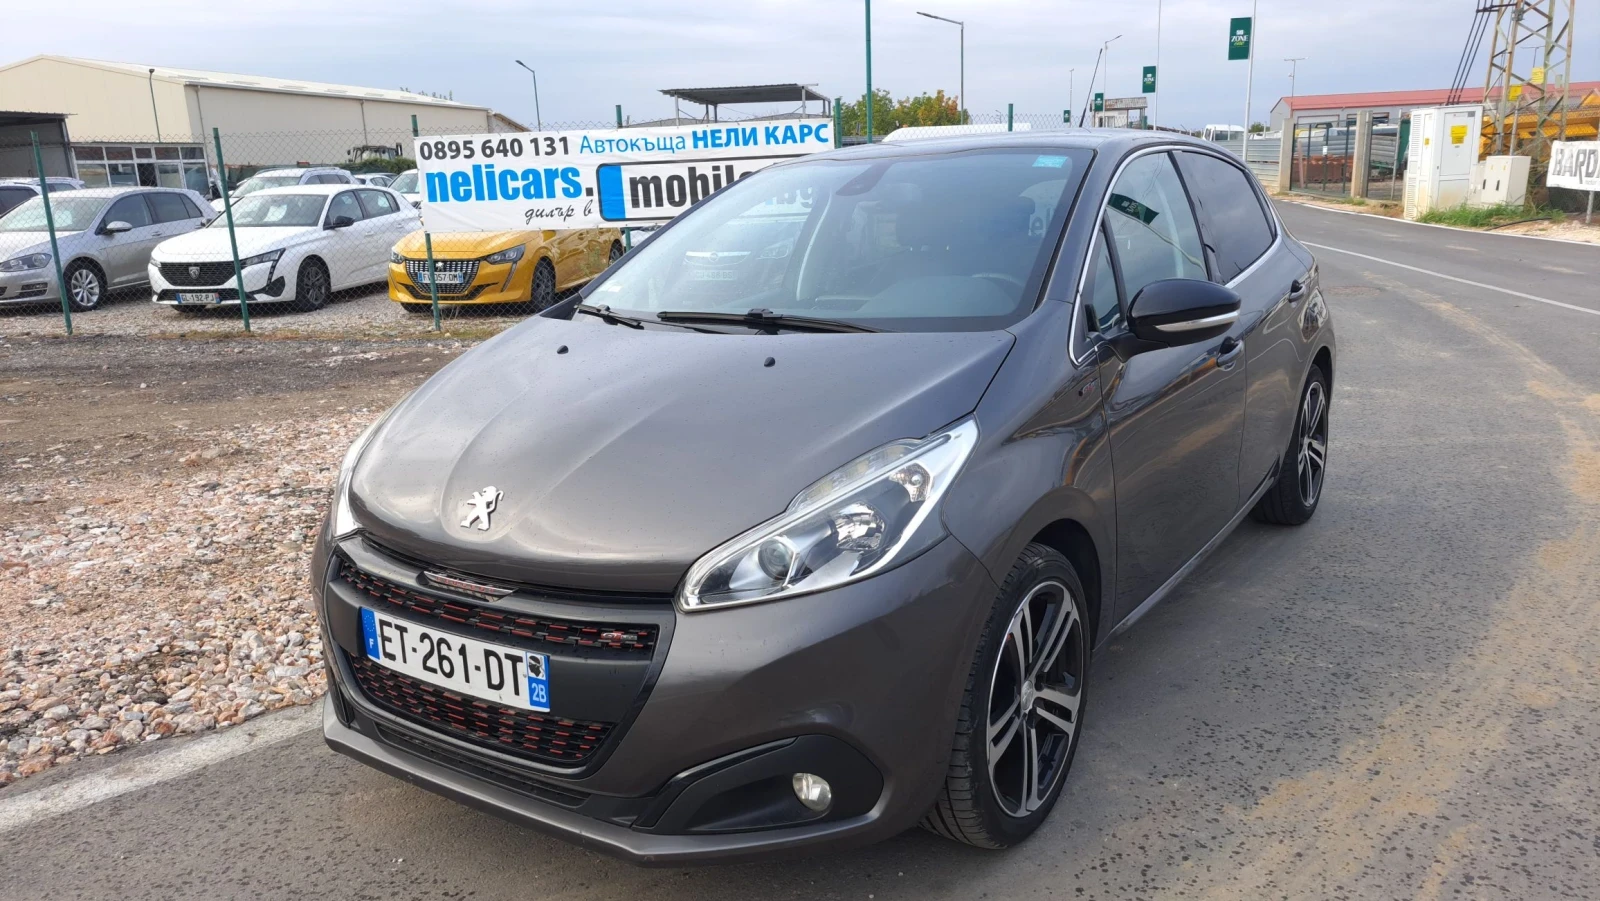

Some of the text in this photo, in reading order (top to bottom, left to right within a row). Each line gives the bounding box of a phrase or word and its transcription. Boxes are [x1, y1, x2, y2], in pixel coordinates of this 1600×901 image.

[419, 123, 829, 160] 0895 640 131 Автокъща НЕЛИ КАРС
[425, 163, 594, 203] nelicars.
[1552, 148, 1600, 184] BARD
[525, 199, 593, 225] дилър в
[369, 618, 547, 703] F ET-261-DT 2B
